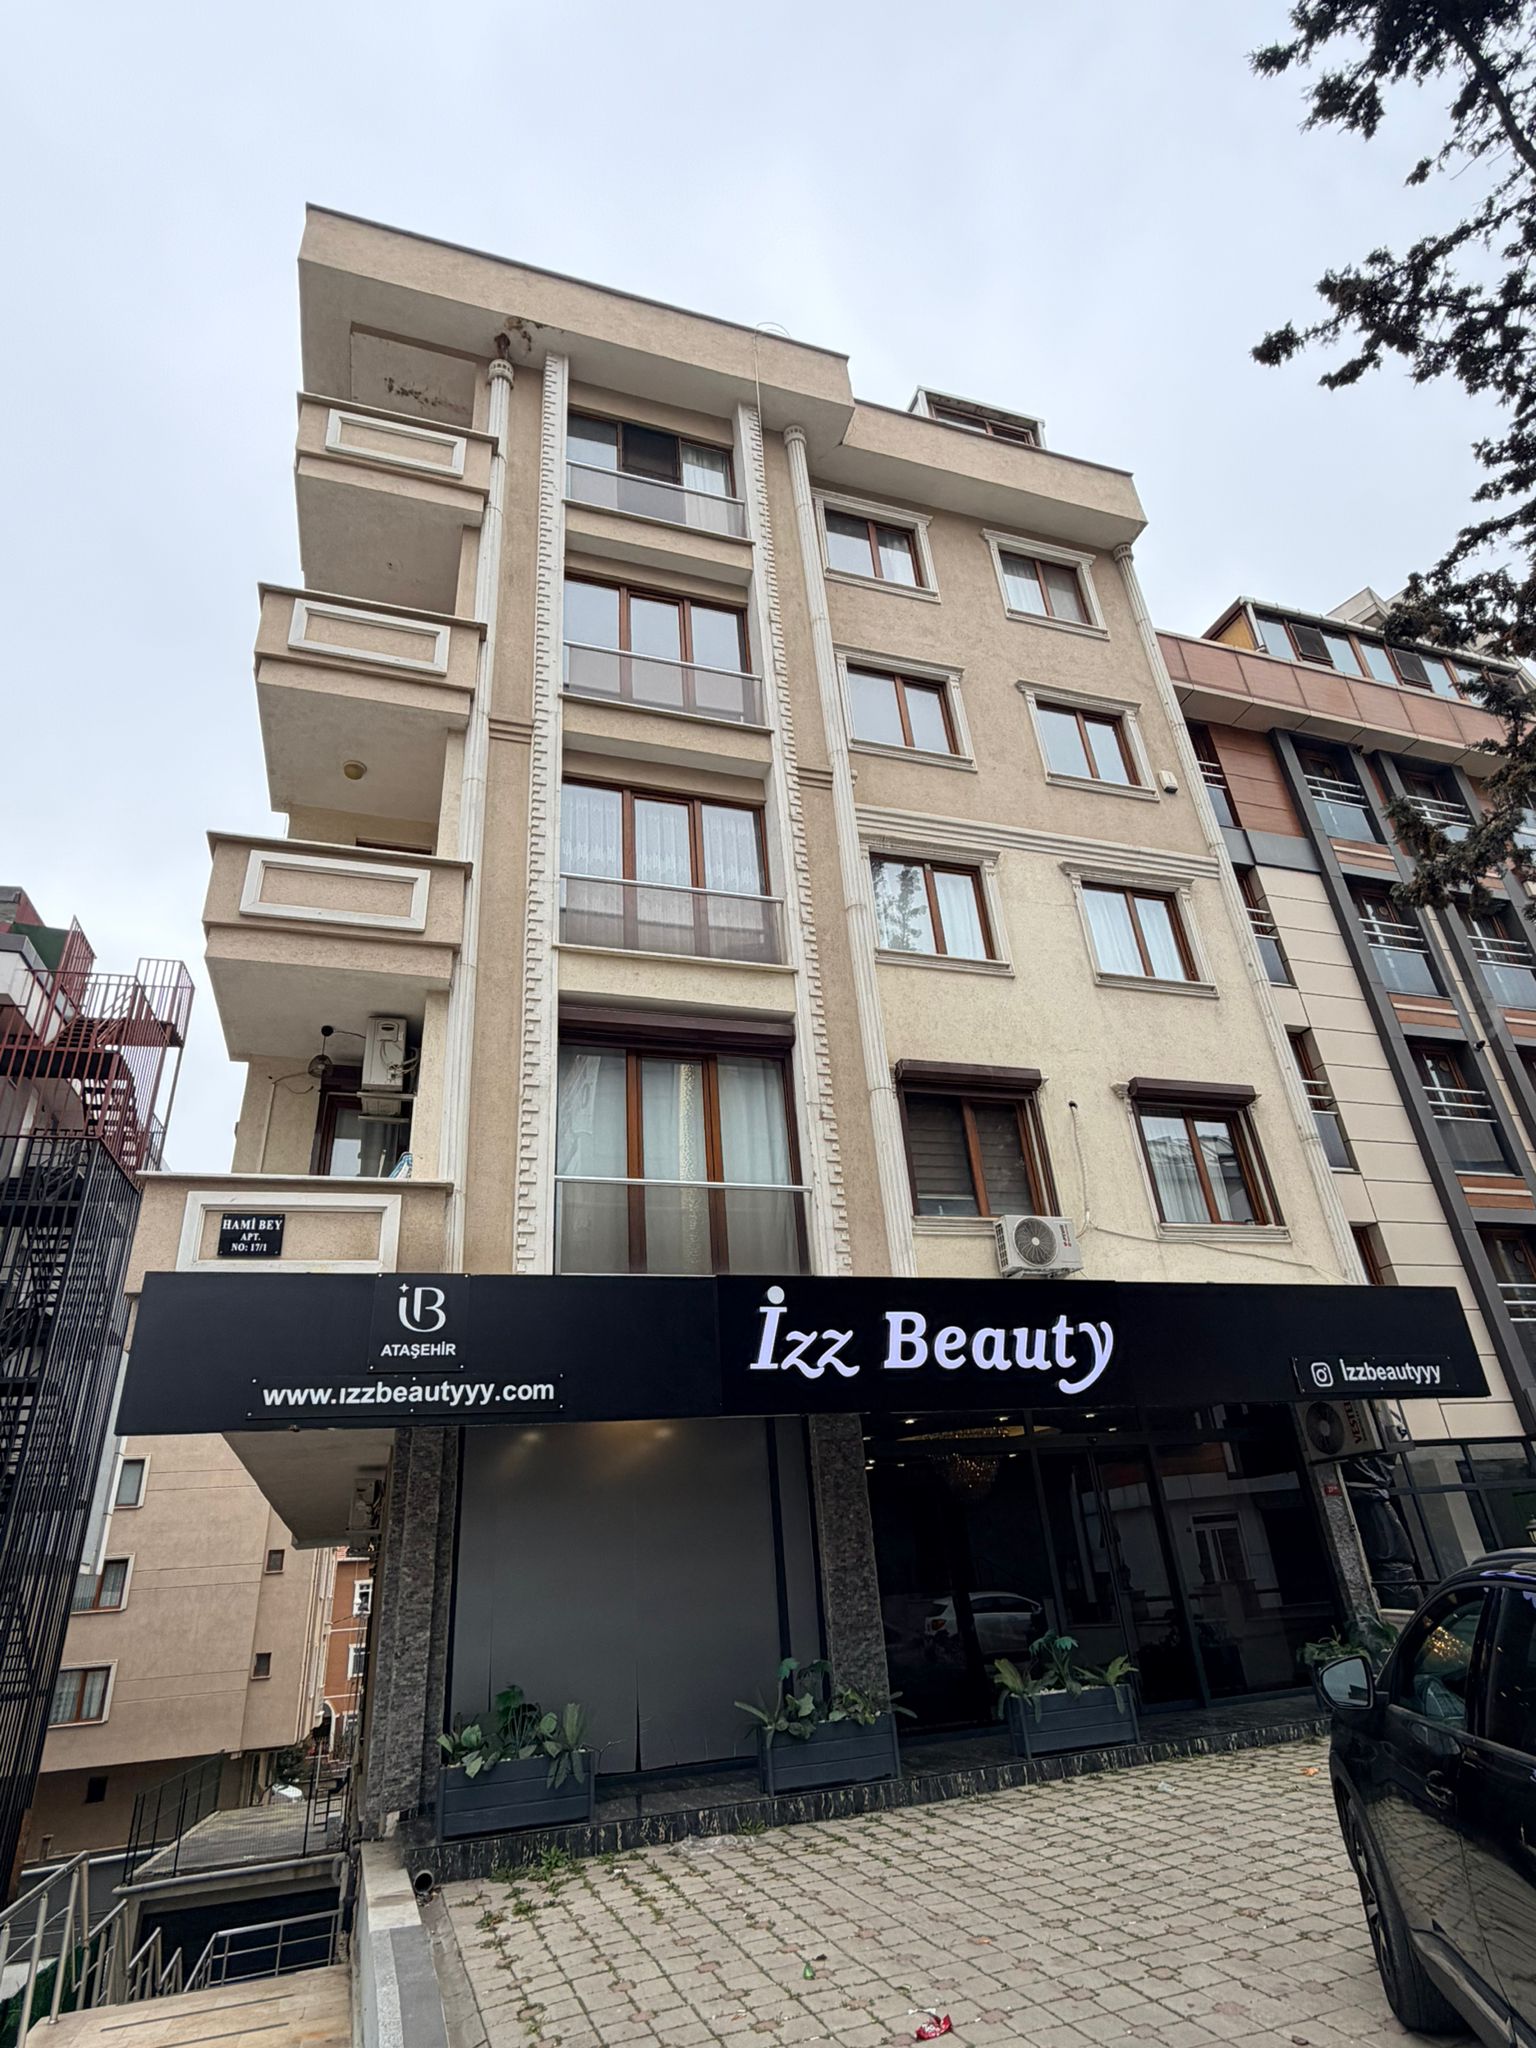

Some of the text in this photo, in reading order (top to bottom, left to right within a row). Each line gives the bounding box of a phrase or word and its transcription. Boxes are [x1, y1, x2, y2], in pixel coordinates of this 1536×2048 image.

[259, 1219, 283, 1230] BEY
[240, 1232, 261, 1241] APT.
[231, 1242, 267, 1252] NO: 17/1
[749, 1285, 1114, 1394] İzz Beauty
[380, 1341, 456, 1359] ATAŞEHİR
